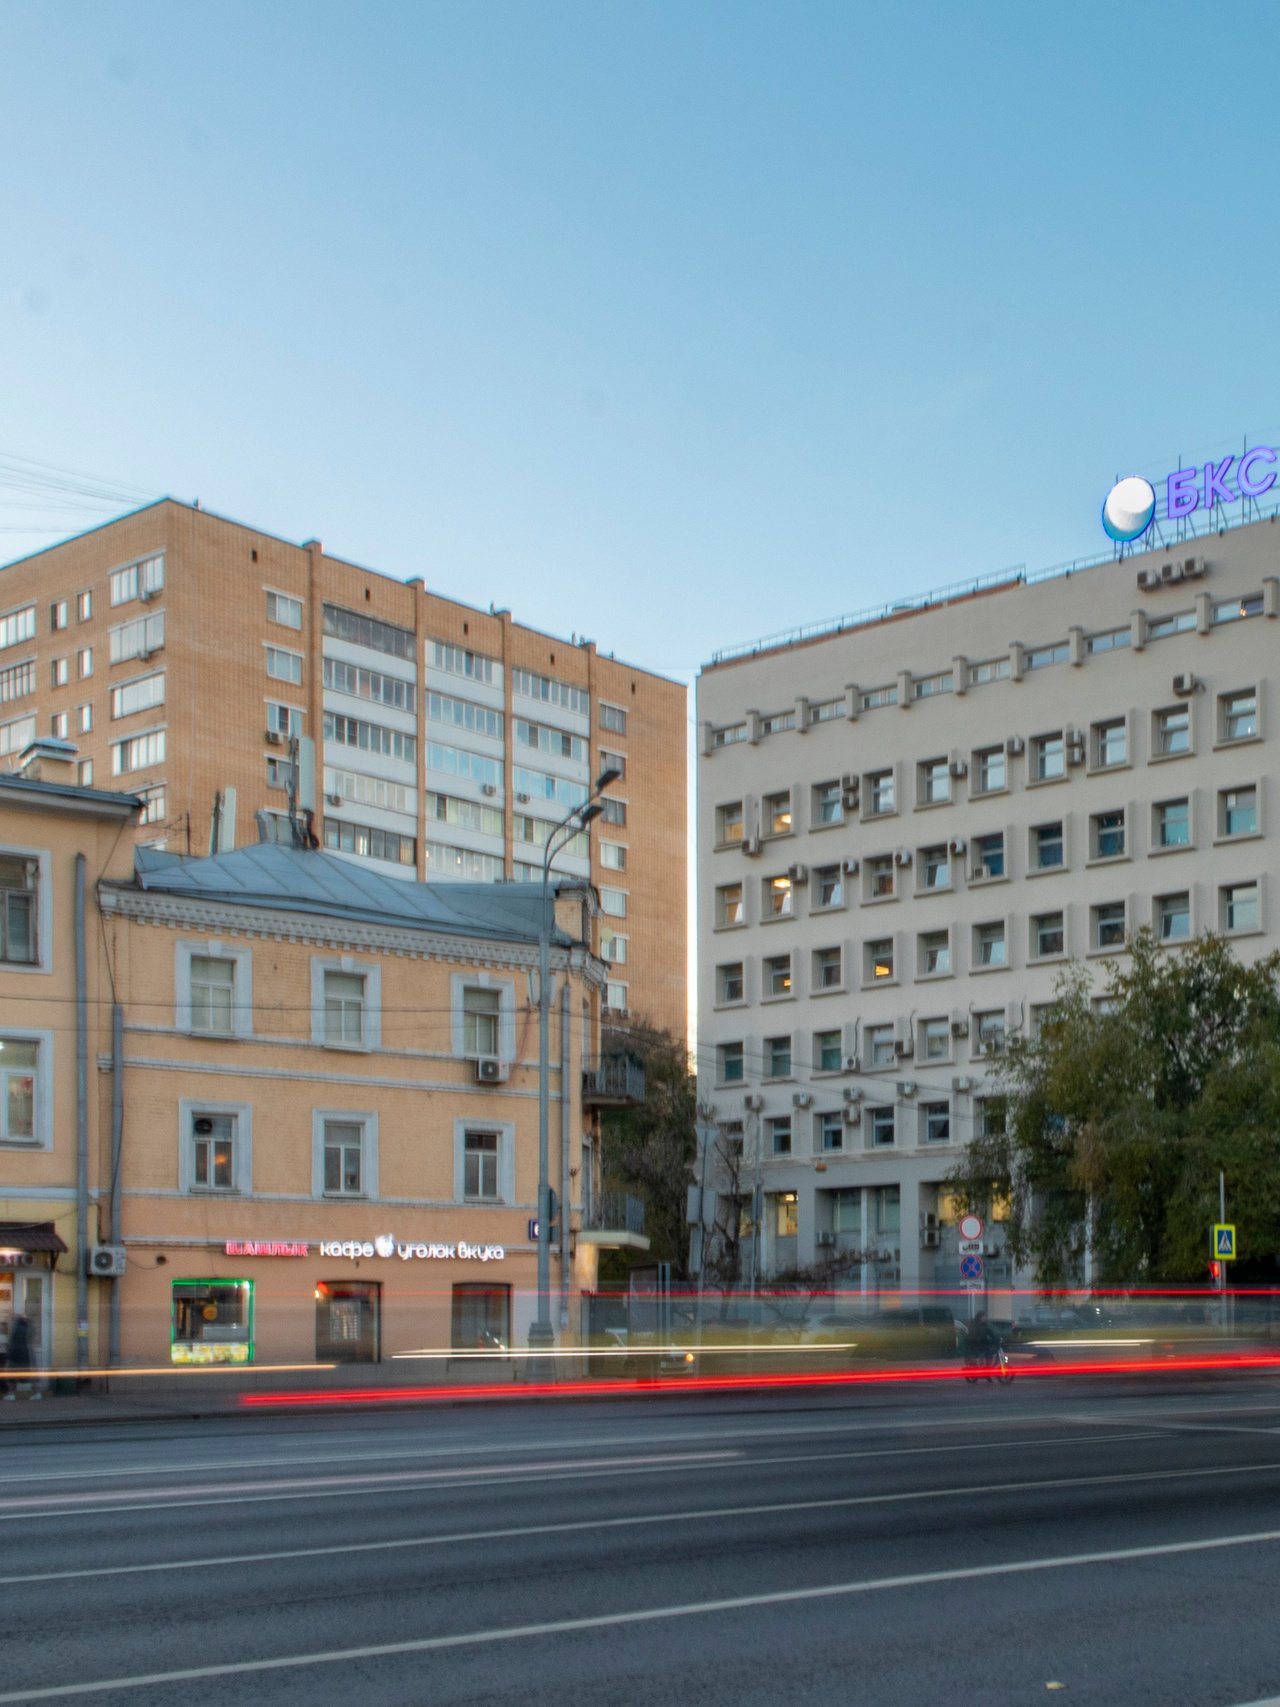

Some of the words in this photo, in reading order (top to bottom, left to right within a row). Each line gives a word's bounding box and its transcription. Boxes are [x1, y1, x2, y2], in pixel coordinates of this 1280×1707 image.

[1167, 447, 1277, 519] БКС
[226, 1240, 308, 1256] ШАШЛЫК
[398, 1243, 456, 1260] уголок
[458, 1241, 505, 1262] вкуса
